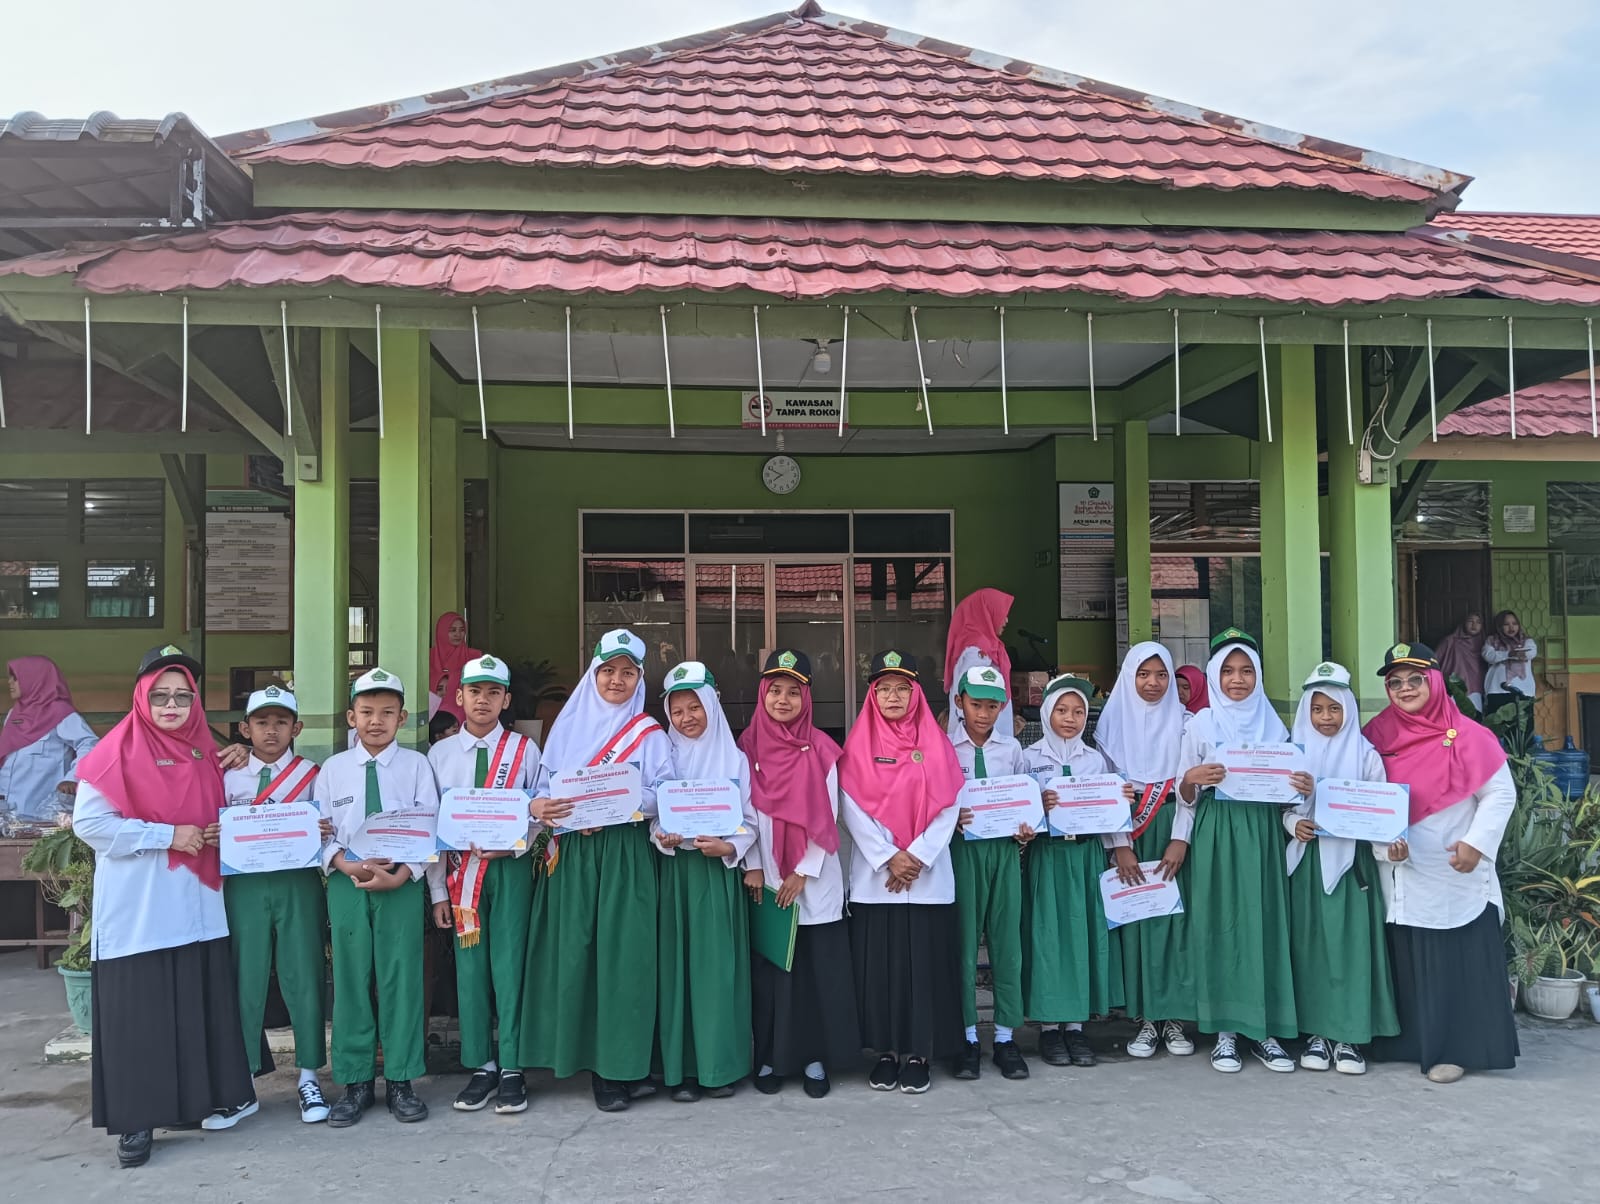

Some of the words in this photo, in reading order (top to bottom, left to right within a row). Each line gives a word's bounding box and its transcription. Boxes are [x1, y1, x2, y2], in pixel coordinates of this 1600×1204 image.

[785, 399, 833, 407] KAWASAN
[776, 408, 807, 416] TANPA
[809, 408, 841, 416] ROKOK
[494, 762, 510, 789] CARA
[1136, 790, 1160, 824] UPACARA
[232, 813, 264, 821] SERTIFIKAT
